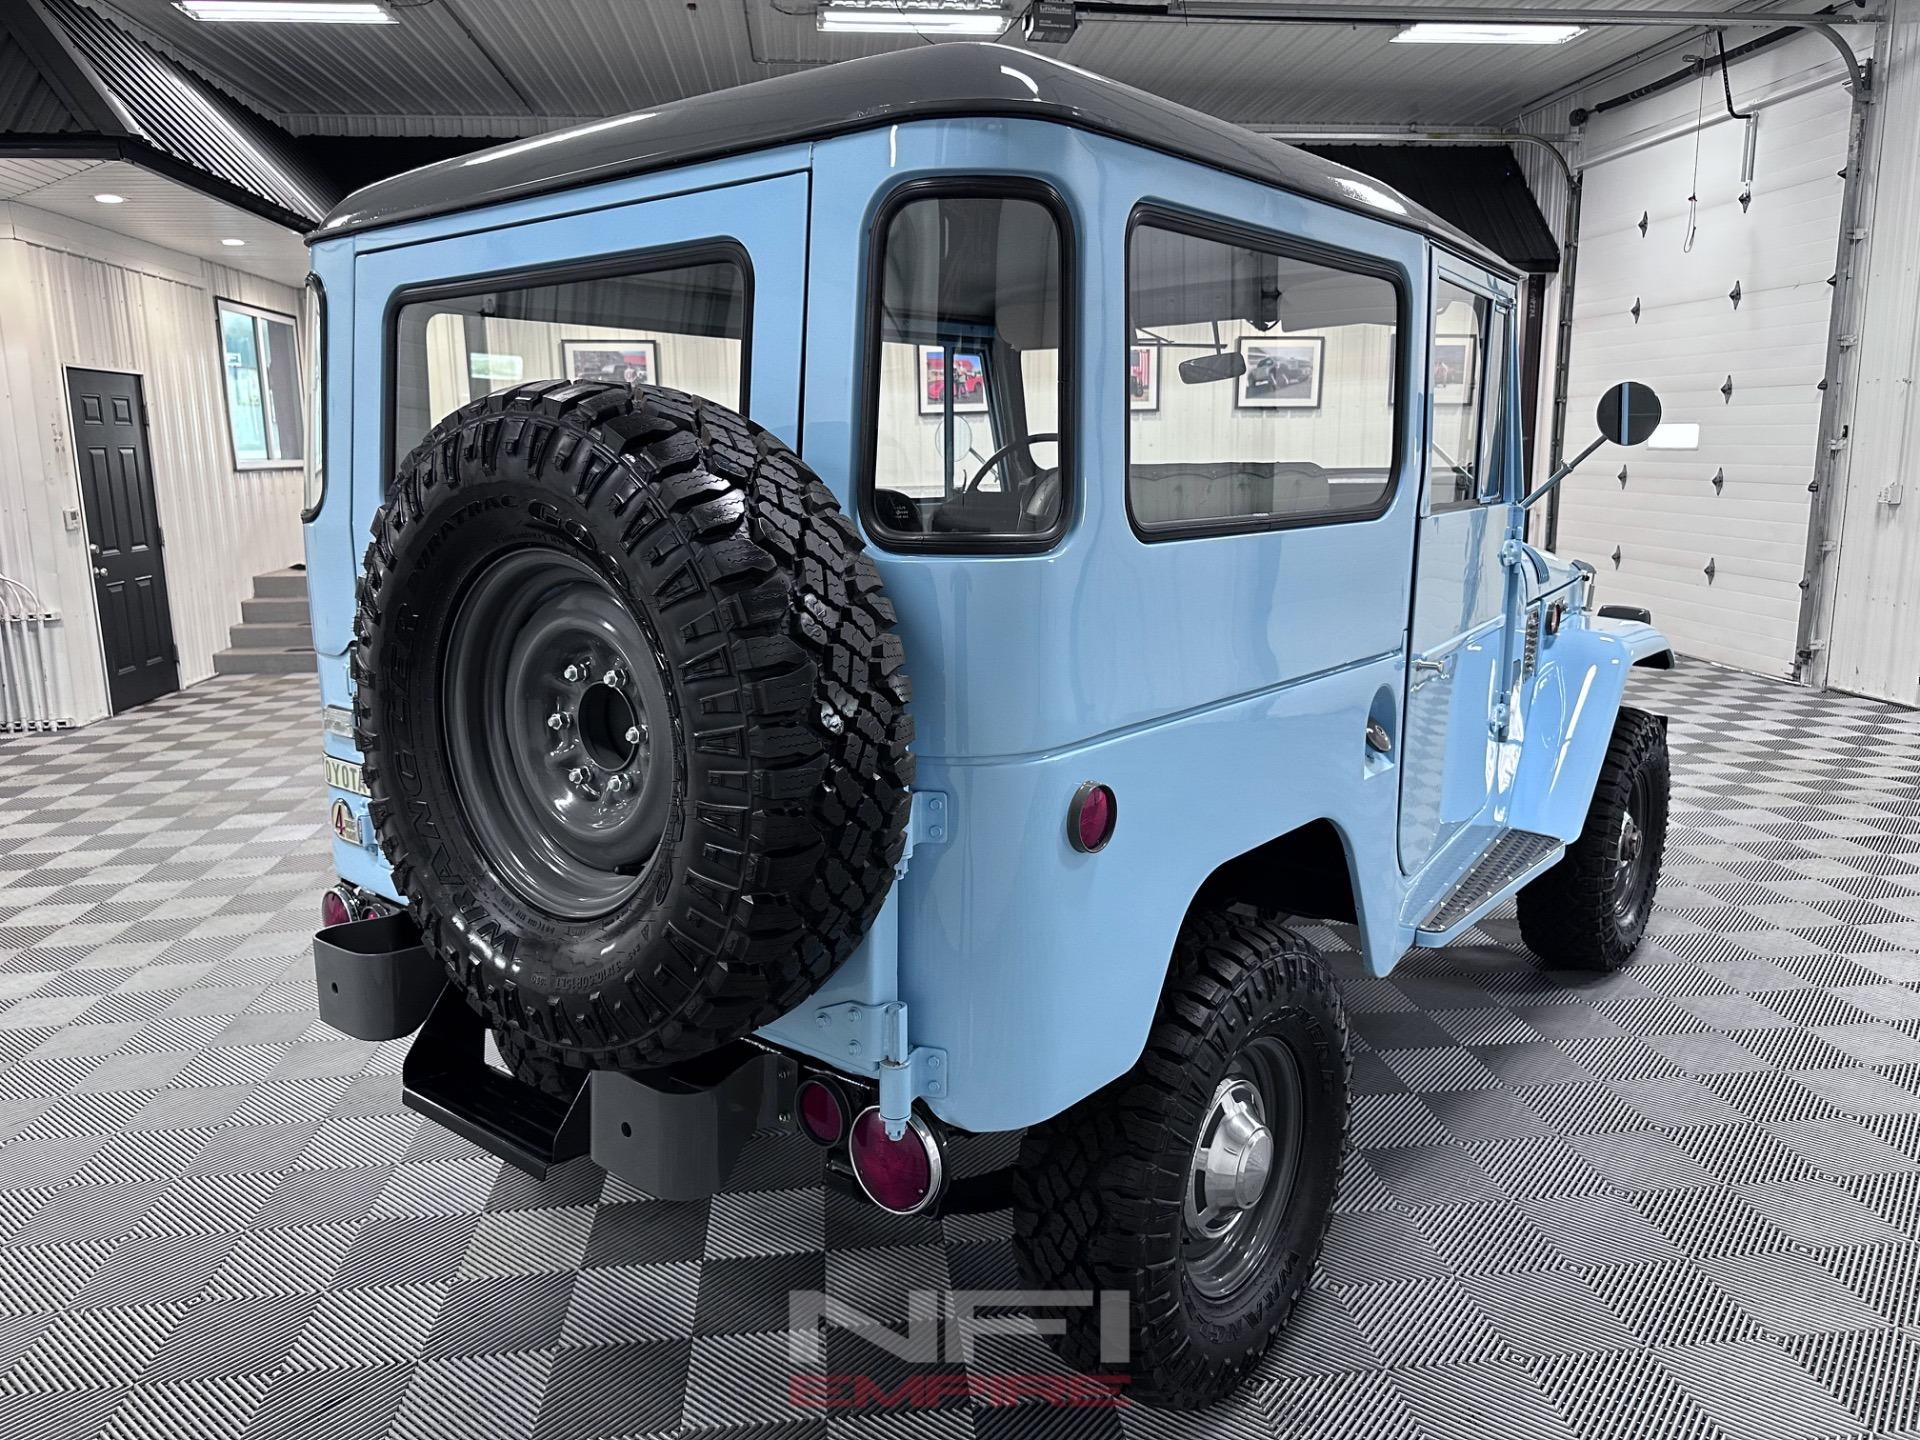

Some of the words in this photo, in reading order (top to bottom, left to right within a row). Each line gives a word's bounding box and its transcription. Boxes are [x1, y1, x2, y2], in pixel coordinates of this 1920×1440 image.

[324, 760, 369, 795] OYOTA
[391, 600, 520, 964] WRANGLER
[335, 804, 346, 835] 4
